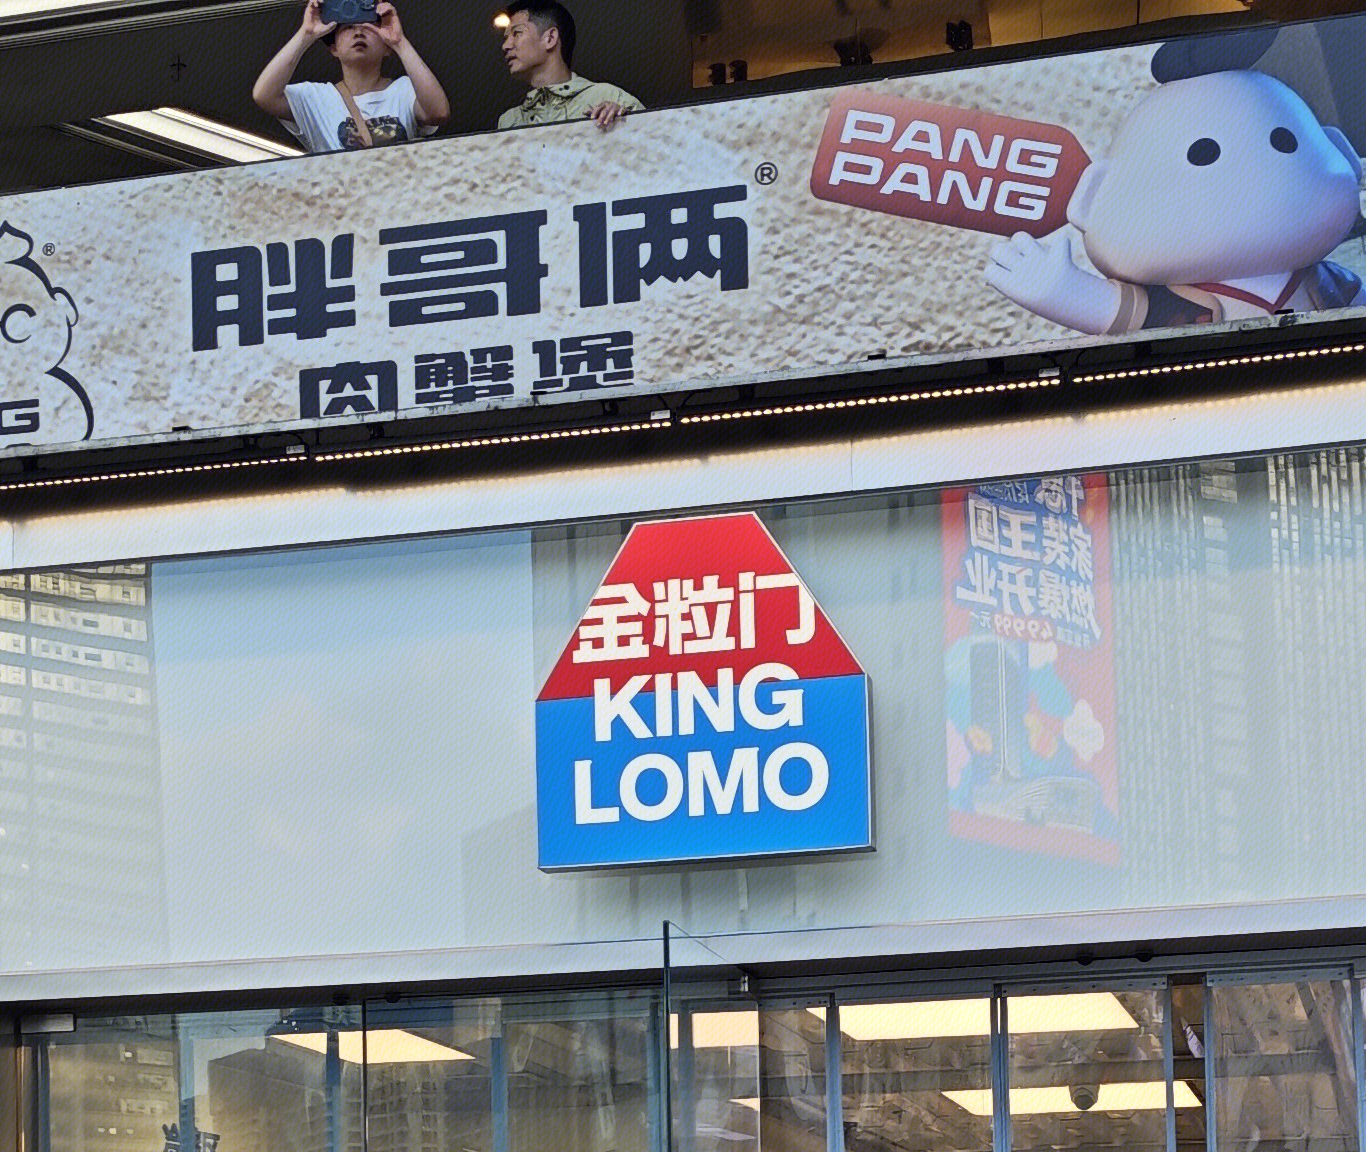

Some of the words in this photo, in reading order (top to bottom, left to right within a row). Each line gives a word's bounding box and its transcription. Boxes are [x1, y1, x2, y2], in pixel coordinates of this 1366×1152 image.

[840, 108, 1063, 177] PANG
[829, 150, 1051, 221] PANG
[191, 185, 749, 352] 胖哥俩
[572, 571, 816, 664] 金粒门
[593, 662, 804, 742] KING
[573, 742, 830, 826] LOMO
